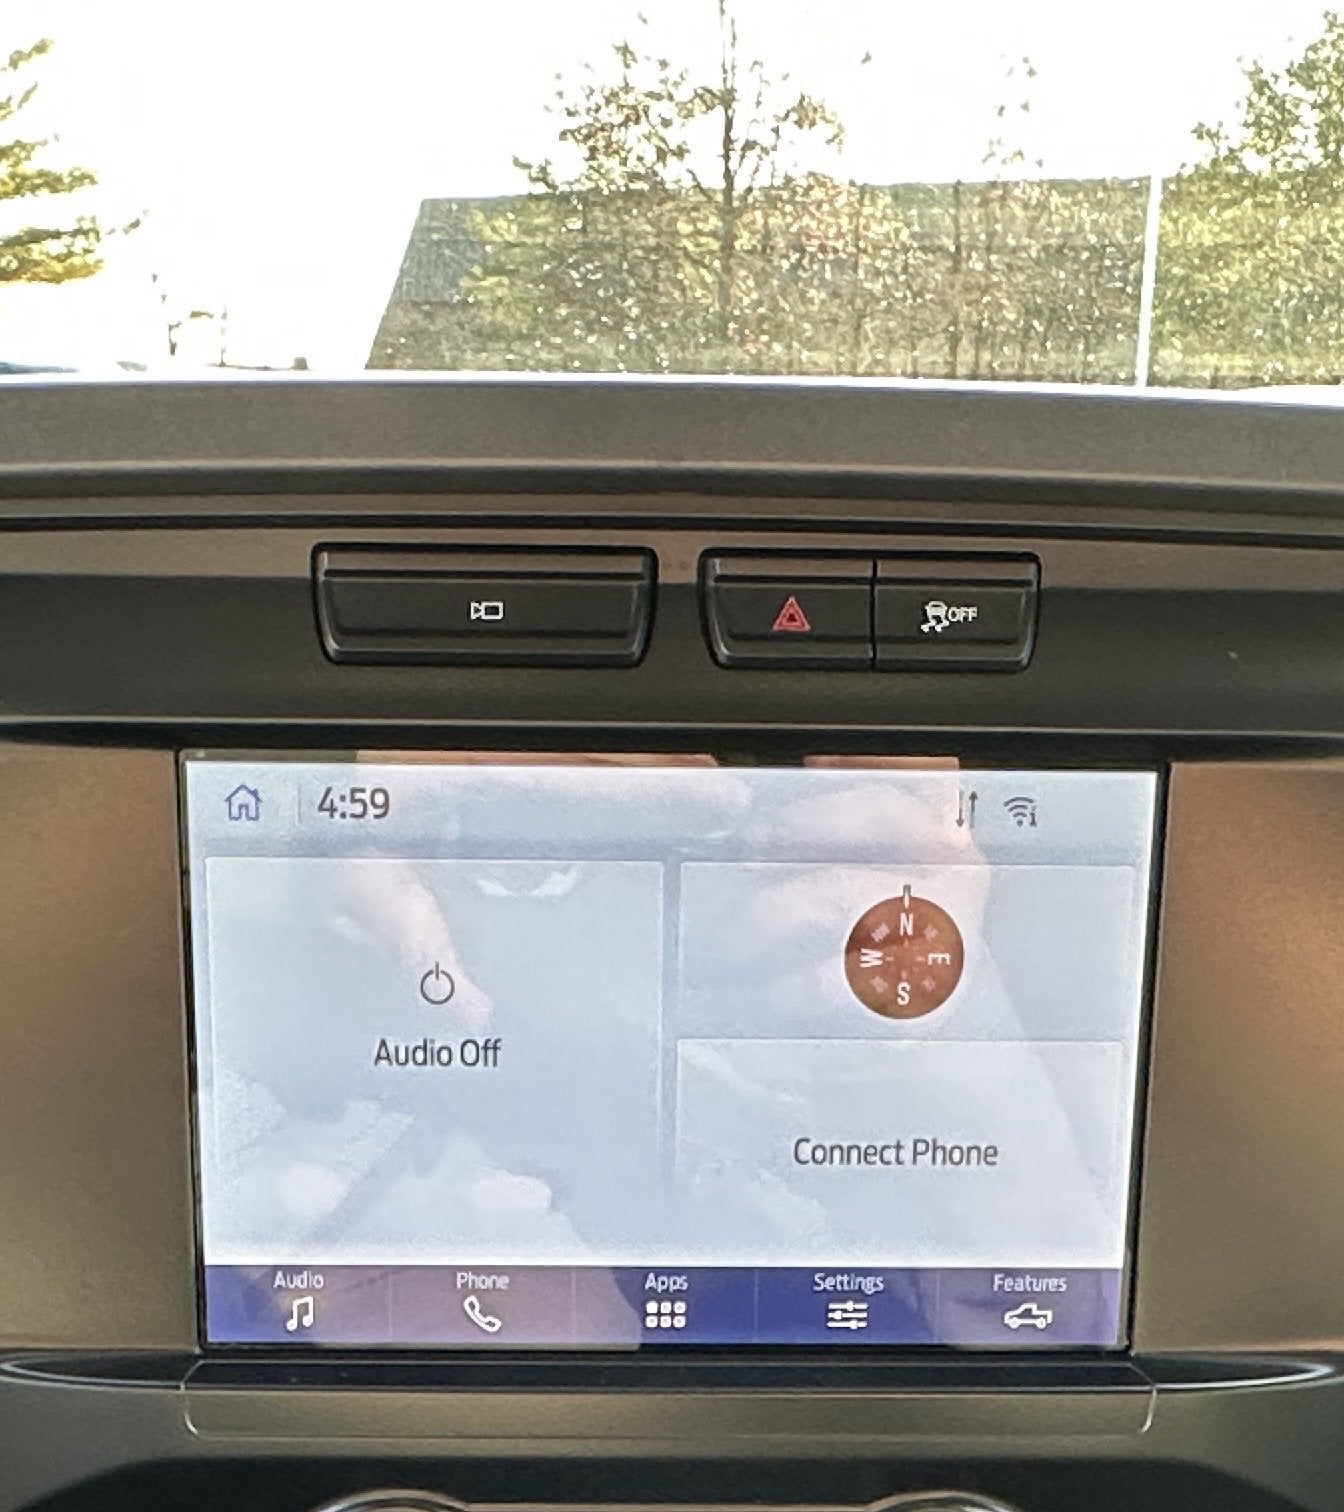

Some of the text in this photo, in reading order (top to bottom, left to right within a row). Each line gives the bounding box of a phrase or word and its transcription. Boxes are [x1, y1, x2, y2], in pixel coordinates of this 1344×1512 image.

[948, 606, 978, 622] OFF
[317, 788, 391, 819] 4:59
[899, 911, 914, 936] N
[859, 948, 884, 968] W
[927, 952, 952, 966] E
[896, 981, 912, 1006] S
[373, 1037, 502, 1067] Audio Off
[793, 1137, 999, 1168] Connect Phone
[272, 1270, 324, 1291] Audio
[455, 1271, 510, 1292] Phone
[644, 1272, 689, 1295] Apps
[813, 1272, 885, 1296] Settings
[992, 1273, 1067, 1294] Features
